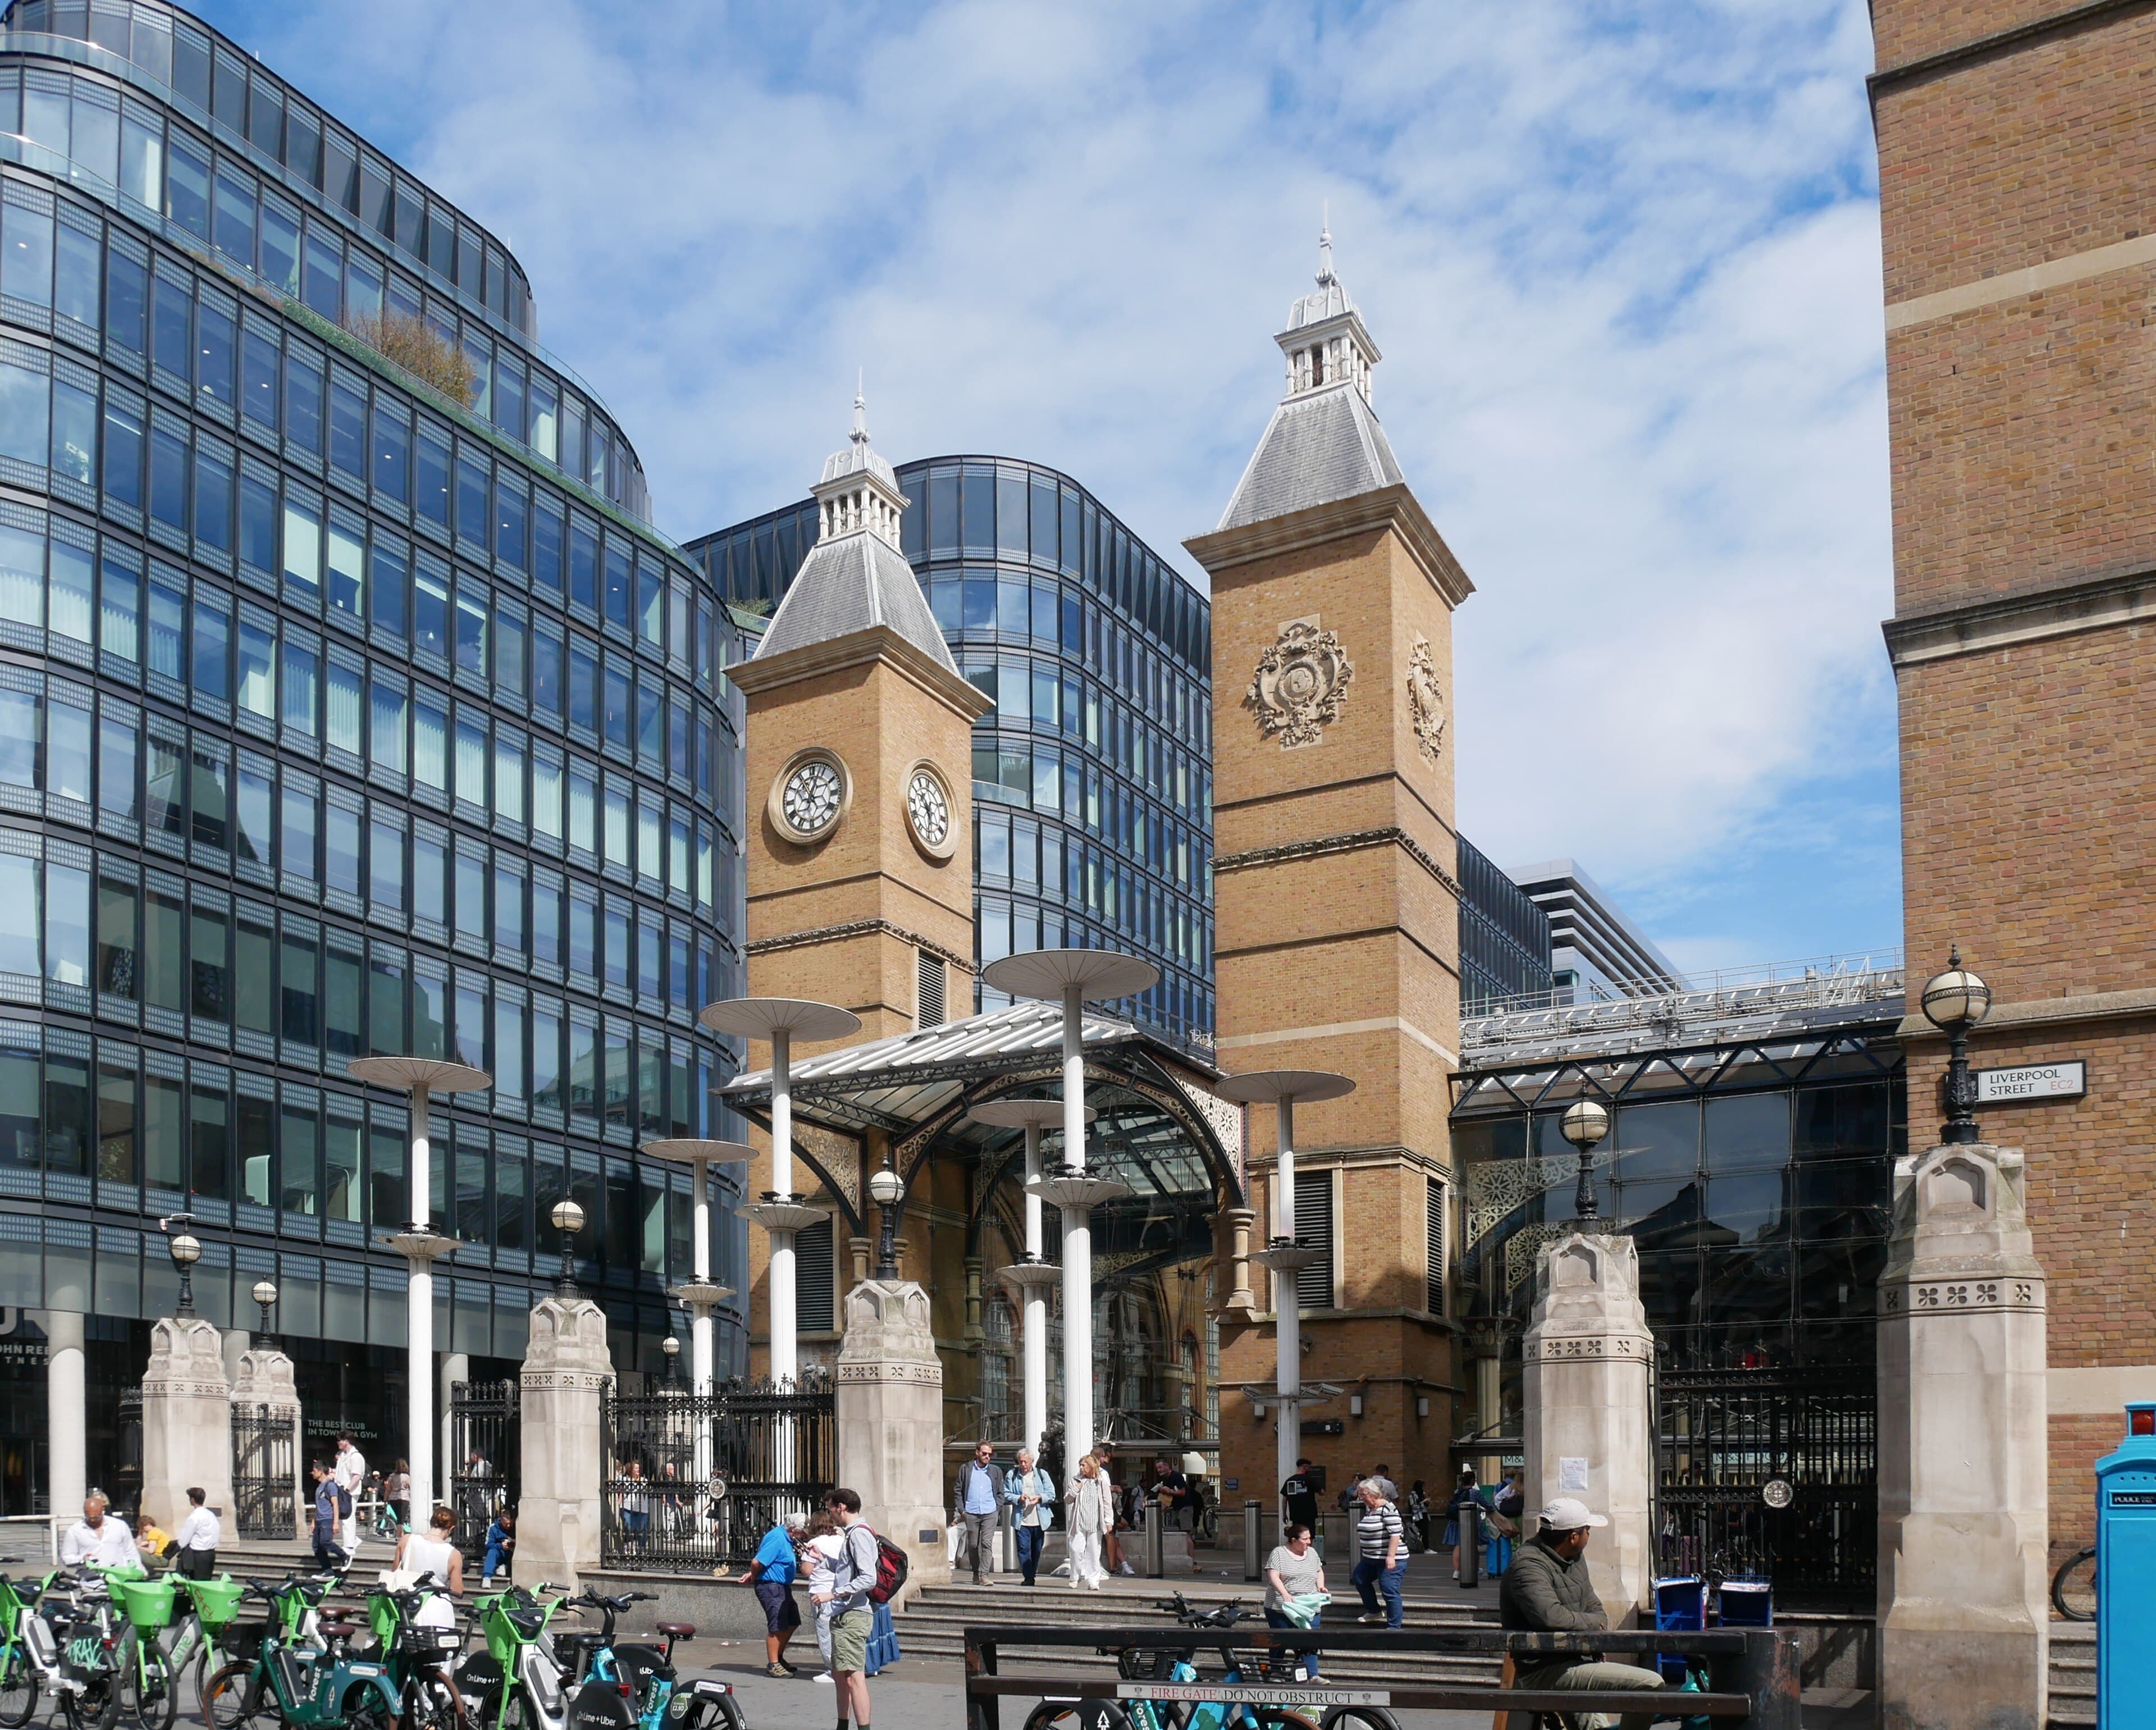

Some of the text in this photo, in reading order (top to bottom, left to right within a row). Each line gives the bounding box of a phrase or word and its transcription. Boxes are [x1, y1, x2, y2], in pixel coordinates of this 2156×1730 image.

[1990, 1069, 2061, 1084] LIVERPOOL
[1990, 1079, 2073, 1096] STREET EC2
[309, 1666, 322, 1702] forest
[646, 1681, 659, 1713] forest
[1151, 1687, 1353, 1704] FIRE GATE DO NOT OBSTRUCT
[600, 1715, 616, 1727] Uber
